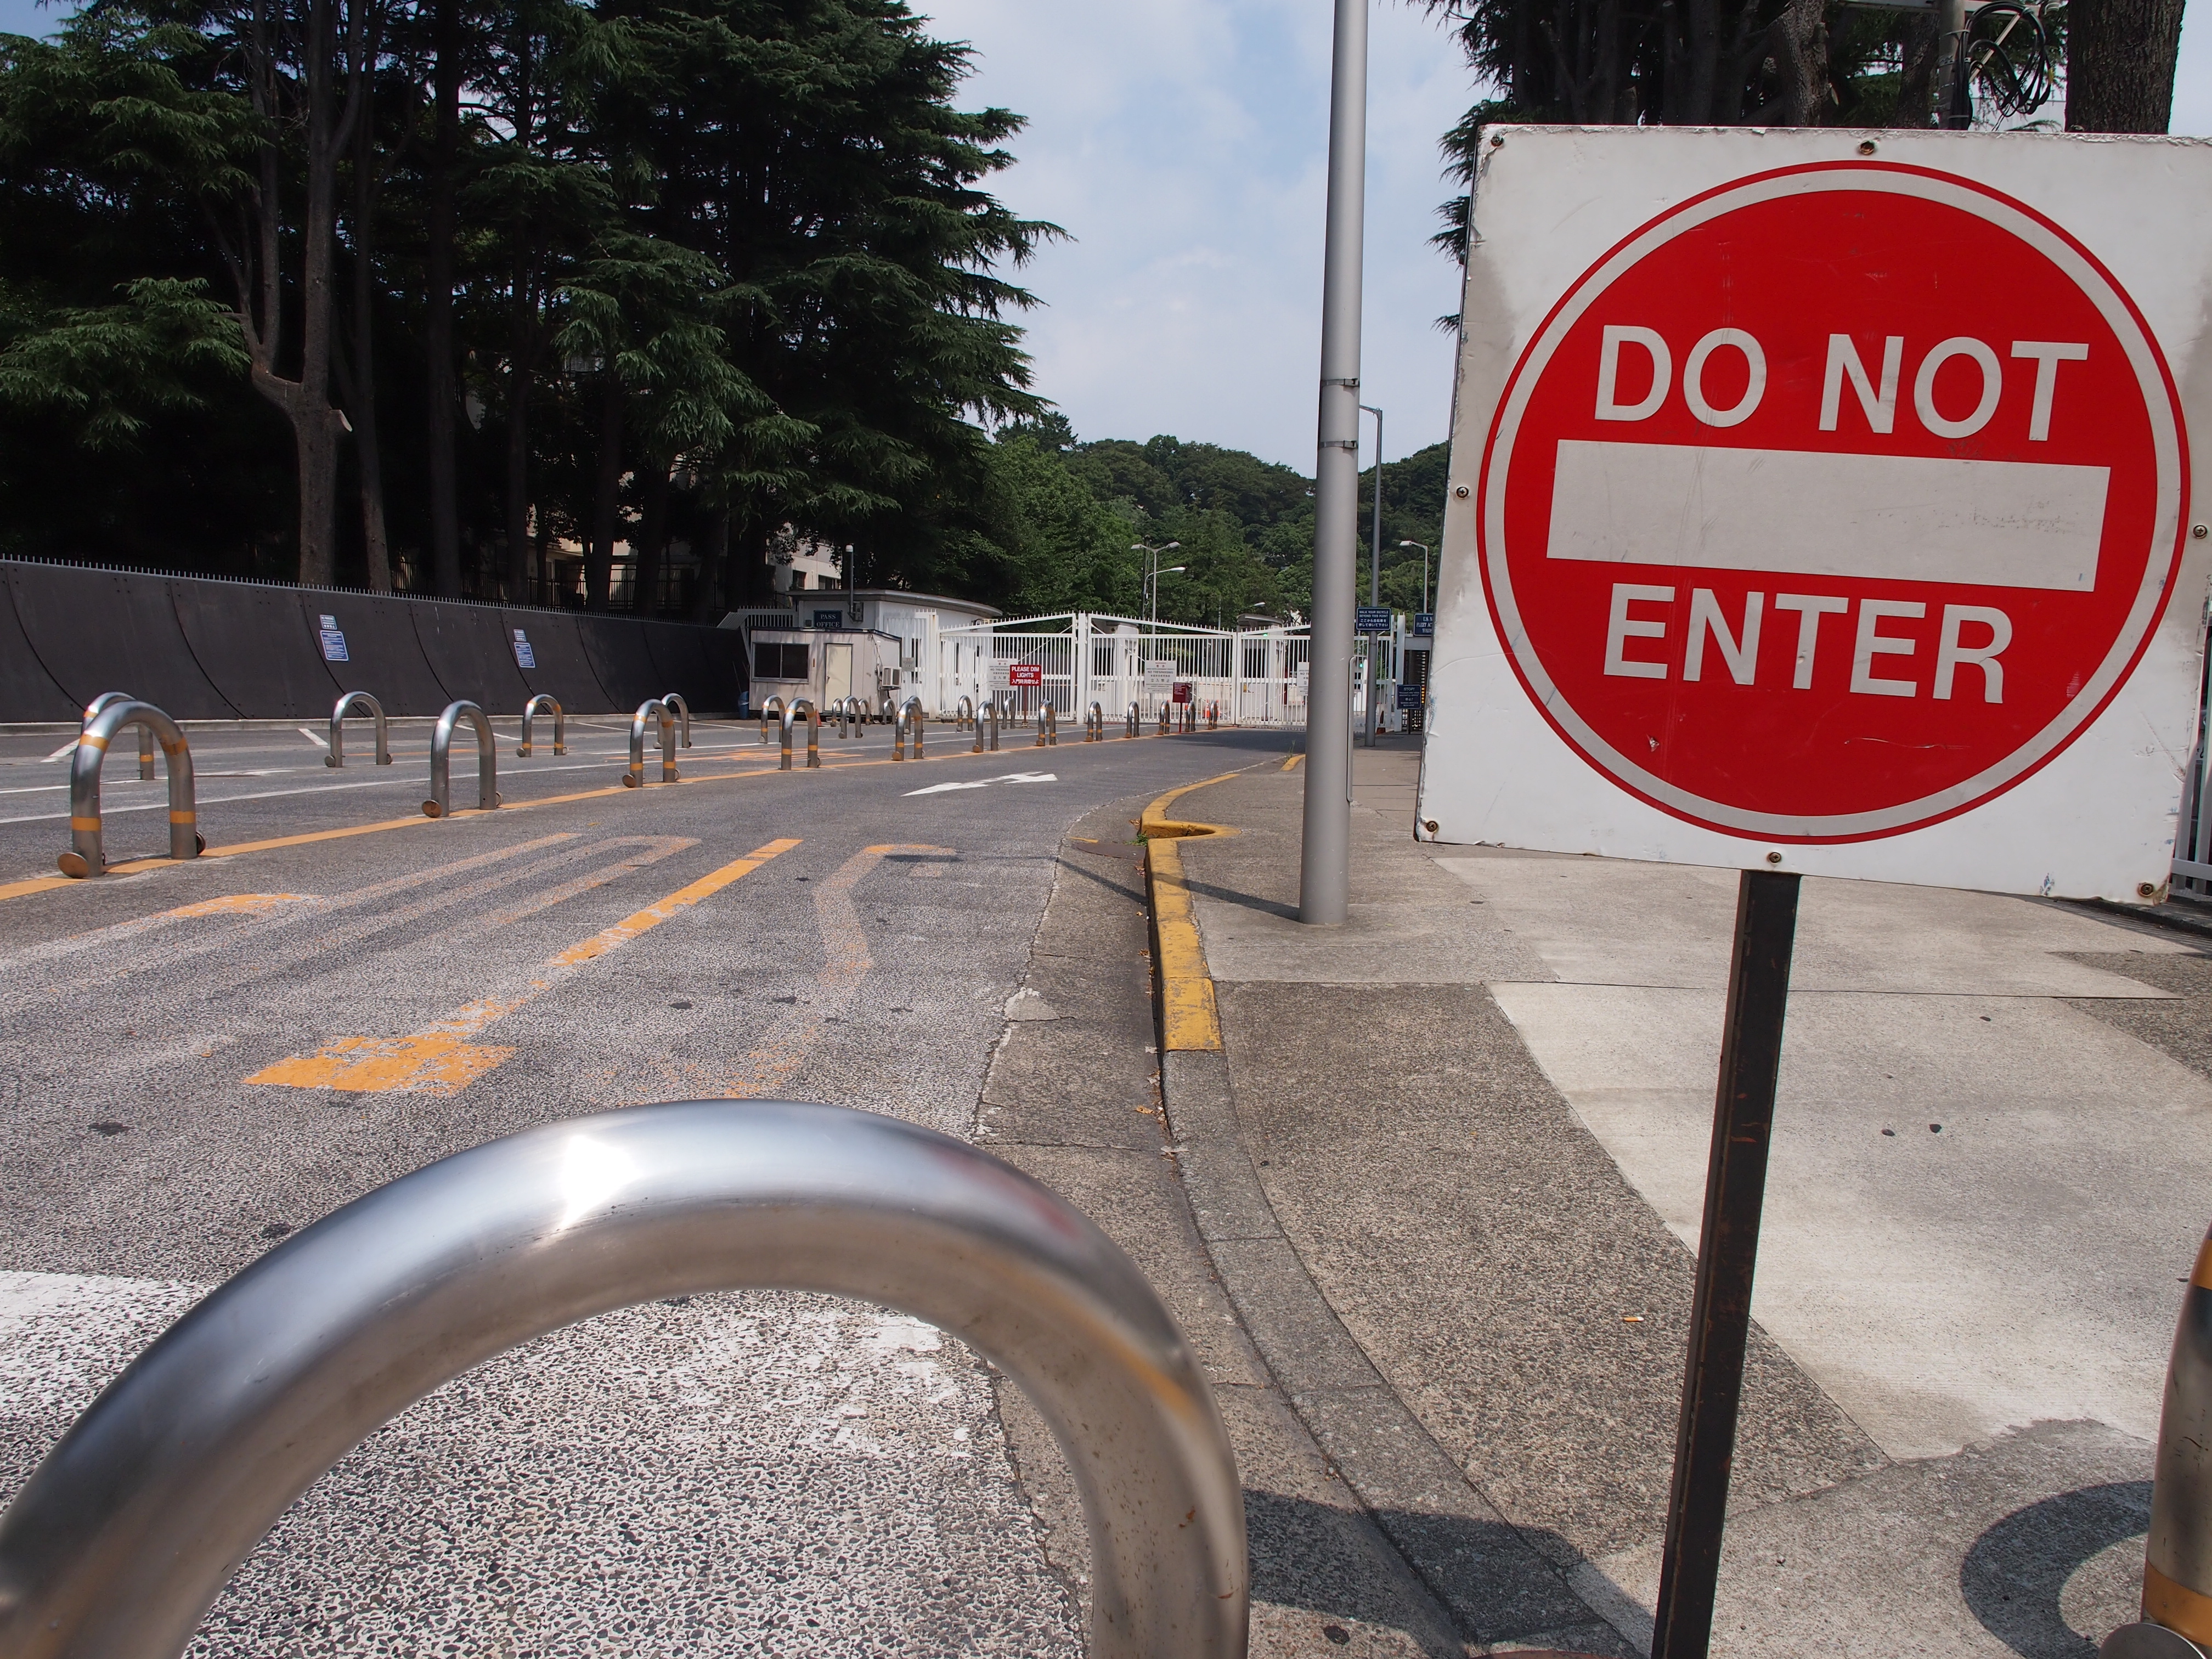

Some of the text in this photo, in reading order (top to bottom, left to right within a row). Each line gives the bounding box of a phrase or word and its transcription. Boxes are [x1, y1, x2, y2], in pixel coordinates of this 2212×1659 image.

[1594, 325, 2089, 442] DO NOT
[1603, 583, 2015, 704] ENTER
